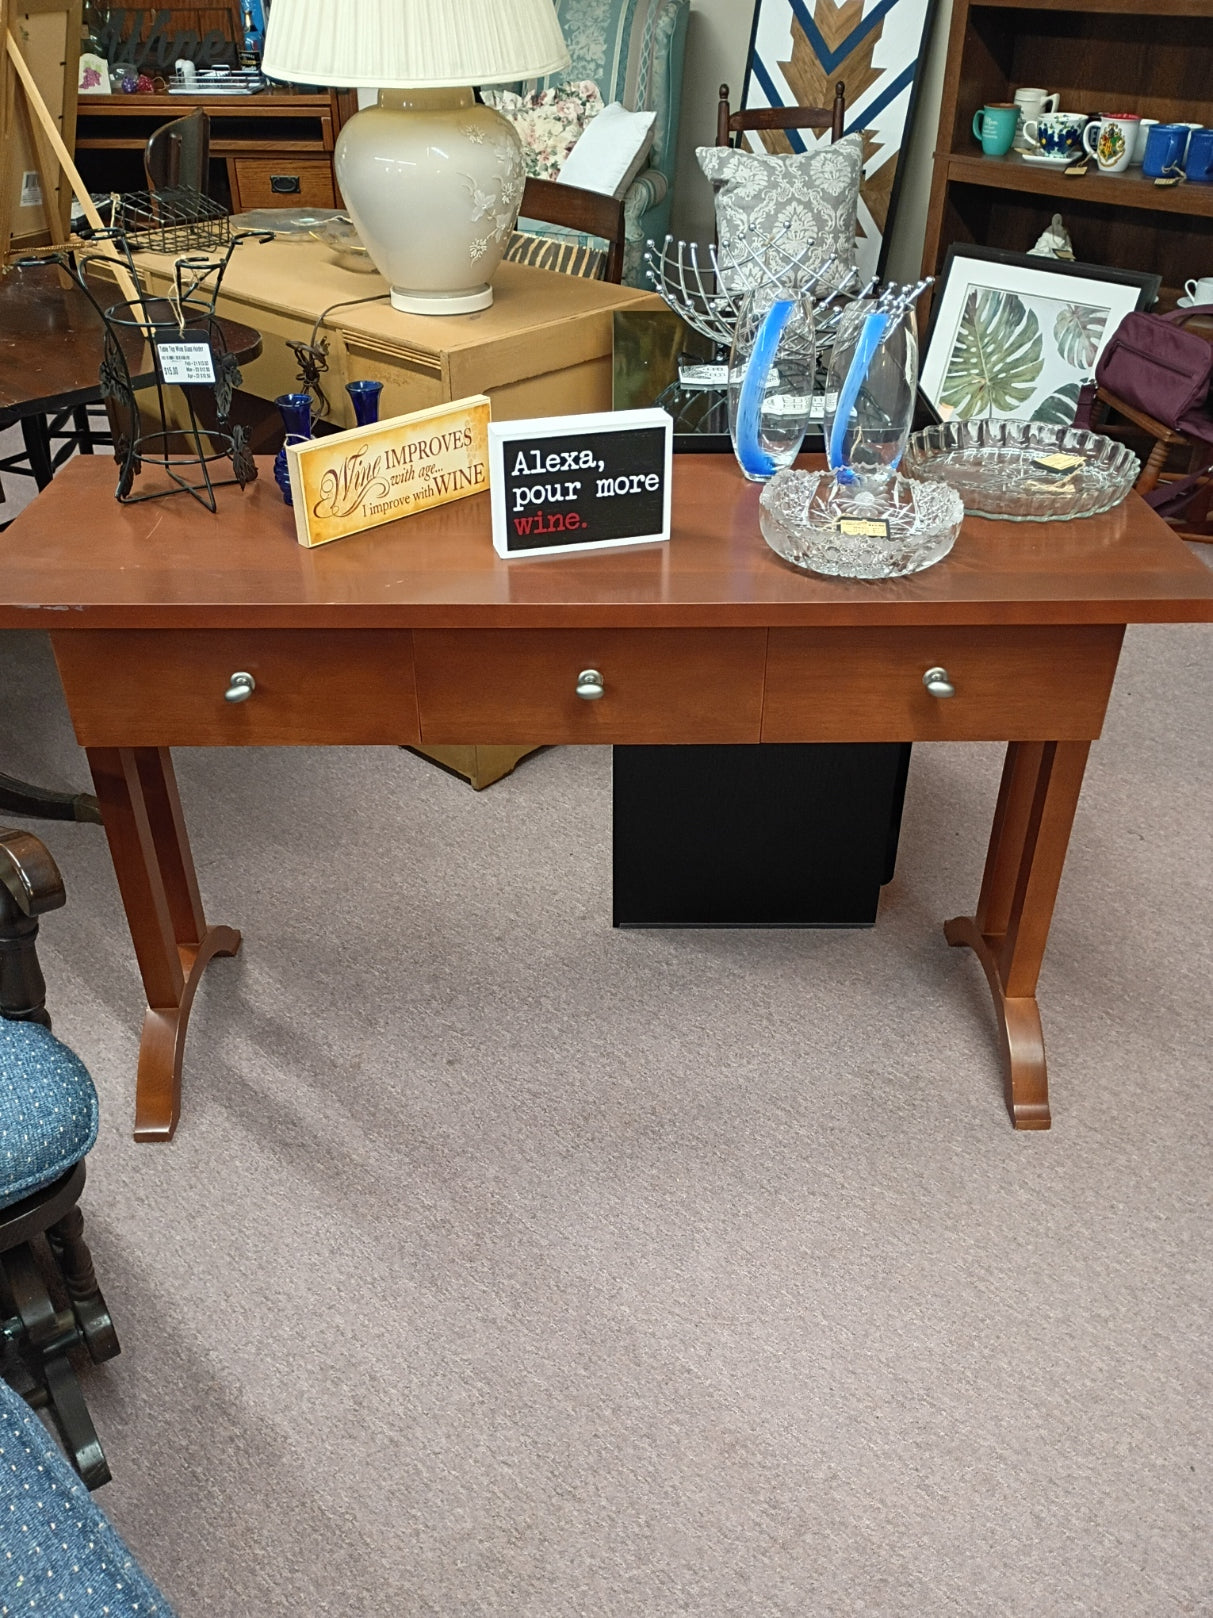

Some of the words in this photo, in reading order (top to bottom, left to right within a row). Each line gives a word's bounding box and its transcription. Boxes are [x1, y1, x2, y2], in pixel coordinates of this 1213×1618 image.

[100, 8, 235, 67] Wine
[313, 444, 389, 518] Wine
[385, 427, 472, 470] IMPROVES
[390, 464, 415, 486] with
[418, 463, 443, 481] age...
[511, 449, 605, 476] Alexa,
[362, 504, 367, 517] I
[369, 494, 410, 514] improve
[413, 485, 435, 501] with
[433, 462, 485, 497] WINE
[512, 480, 581, 512] pour
[596, 473, 660, 497] more
[513, 510, 588, 536] wine.
